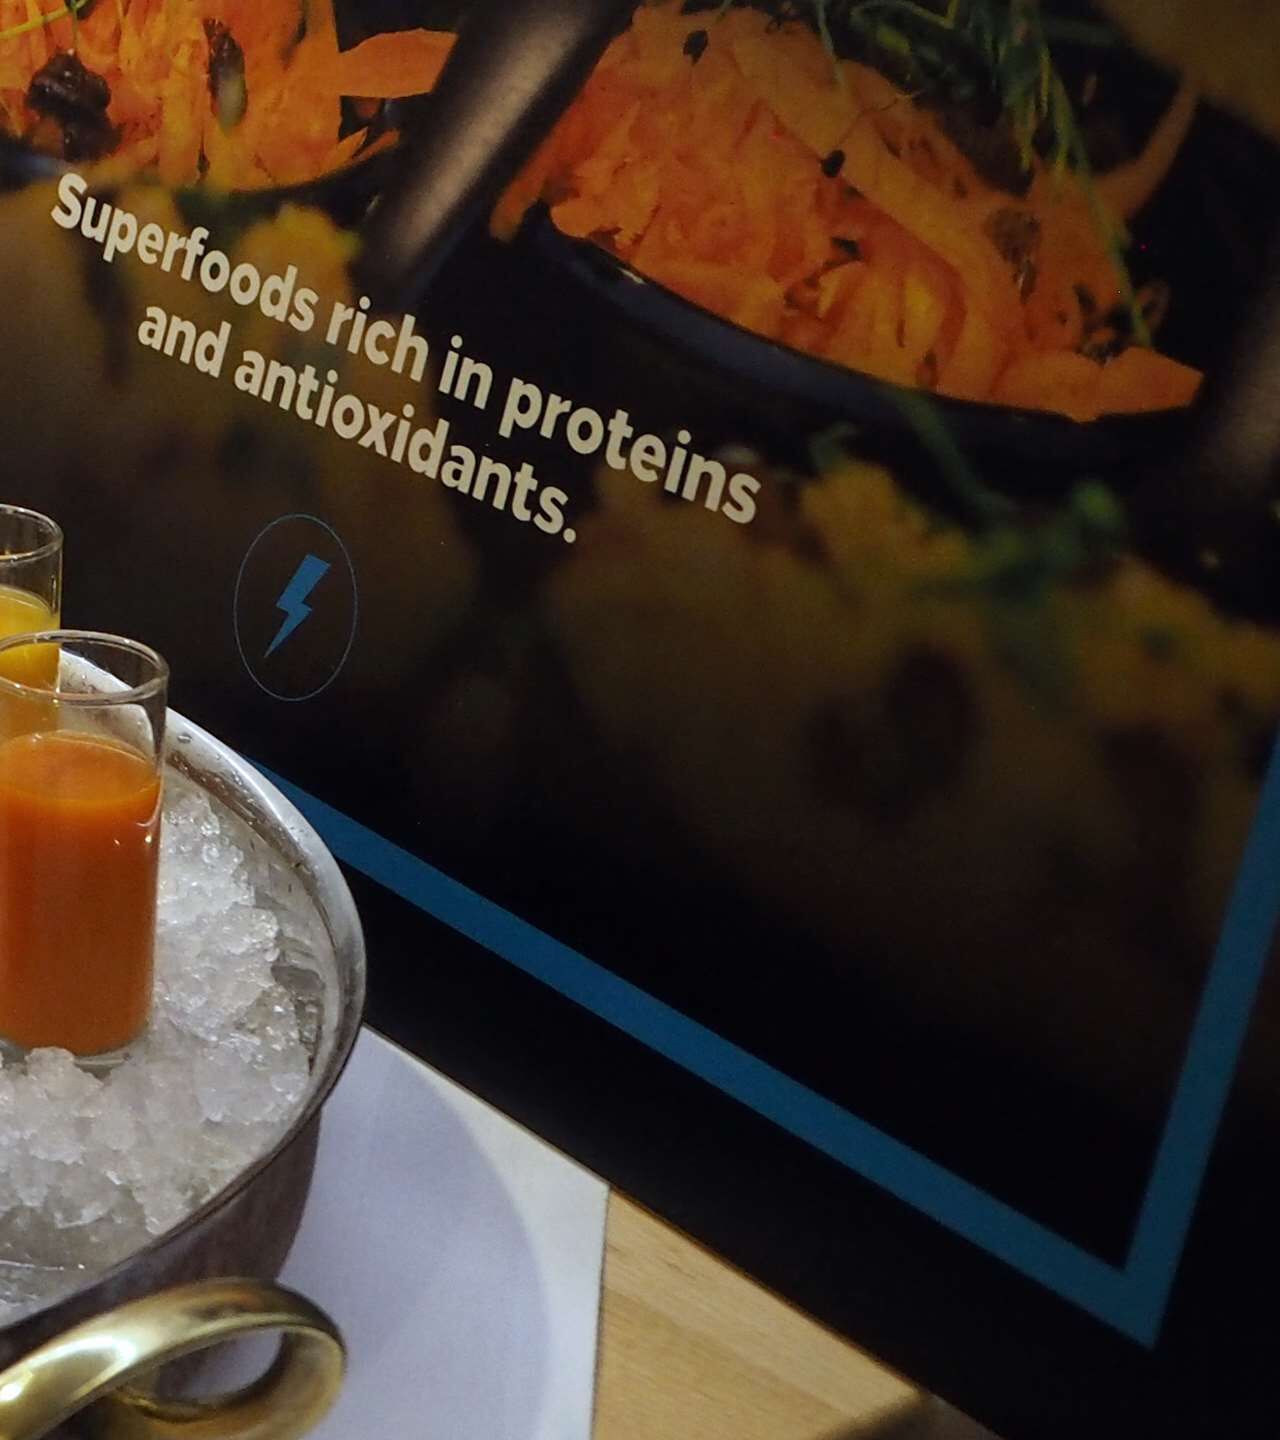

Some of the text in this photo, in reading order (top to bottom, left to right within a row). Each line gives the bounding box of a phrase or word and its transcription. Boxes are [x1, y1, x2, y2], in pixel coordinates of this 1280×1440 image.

[50, 172, 762, 527] Superfoods rich in proteins
[137, 302, 580, 544] and antioxidants.
